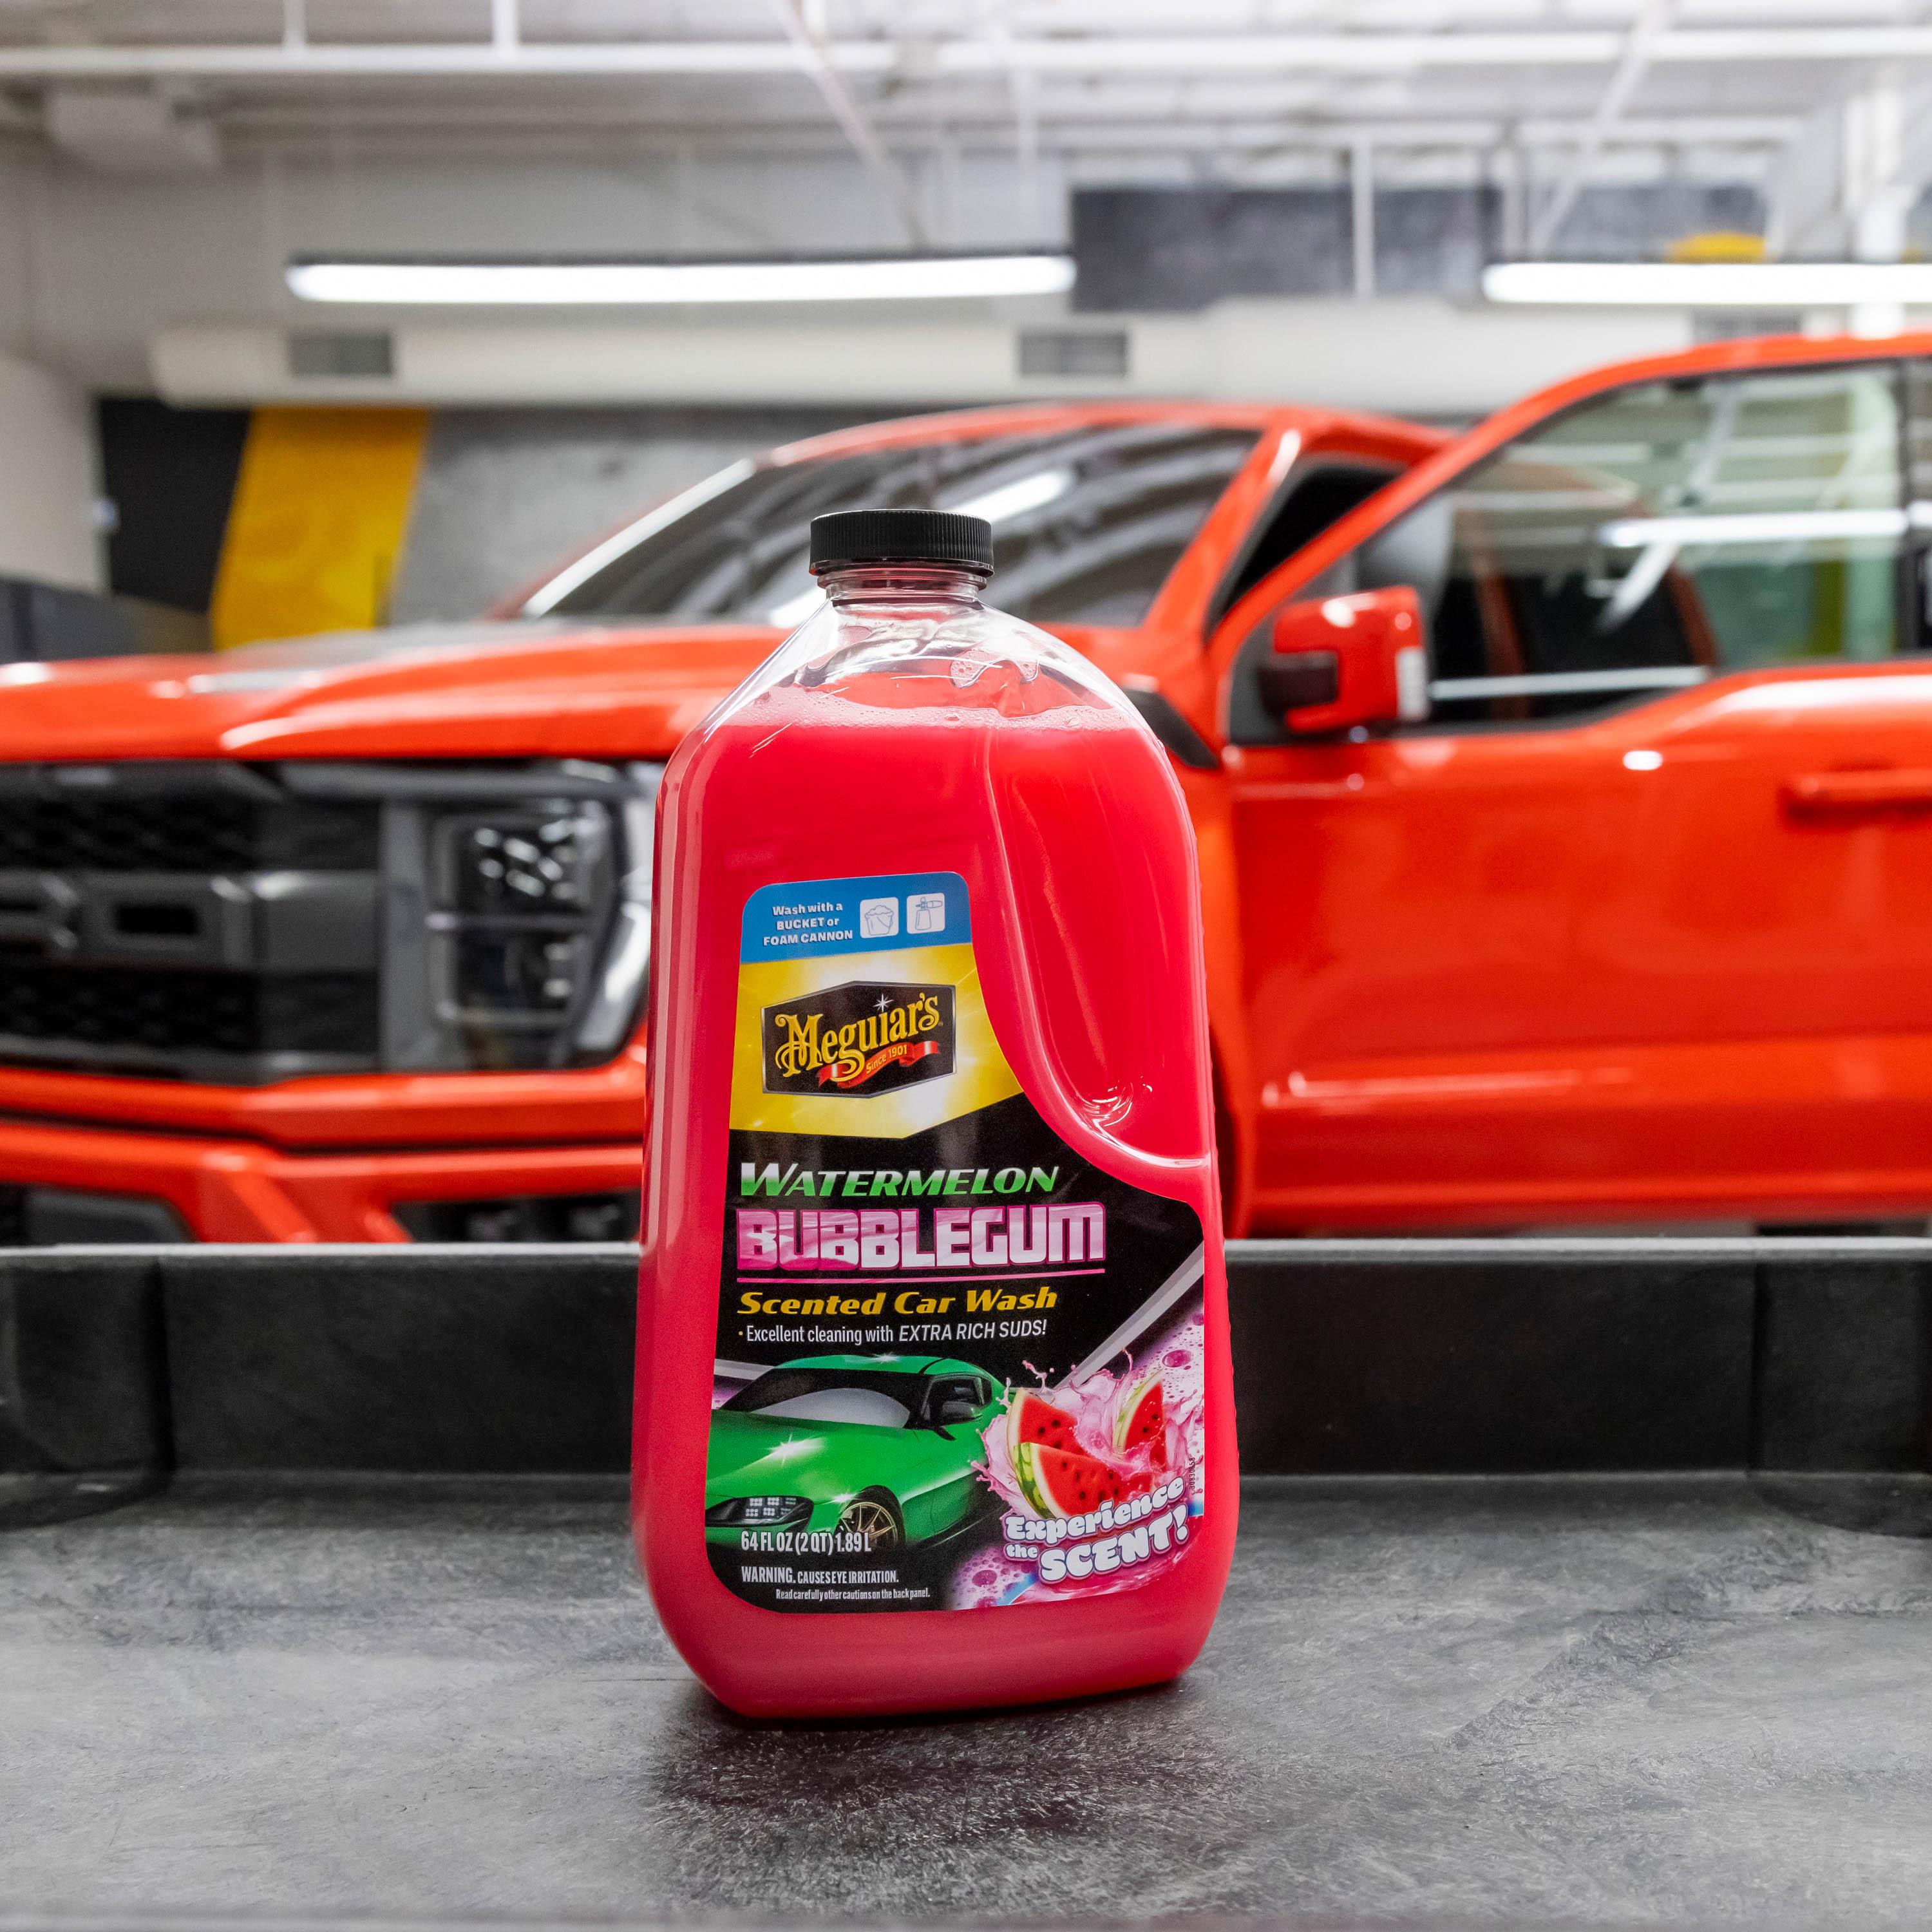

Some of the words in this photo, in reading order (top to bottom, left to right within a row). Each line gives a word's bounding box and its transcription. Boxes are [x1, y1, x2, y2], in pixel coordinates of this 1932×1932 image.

[772, 904, 805, 916] Wash
[808, 902, 833, 913] with
[836, 903, 843, 911] a
[777, 918, 824, 931] BUCKET
[826, 918, 840, 926] or
[763, 934, 799, 946] FOAM
[800, 931, 853, 943] CANNON
[775, 992, 940, 1082] Meguiar's
[866, 1055, 887, 1074] Since
[888, 1045, 907, 1061] 1901
[741, 1162, 1059, 1197] WATERMELON
[737, 1202, 1106, 1271] BUBBLEGUM
[737, 1291, 886, 1315] Scented
[895, 1290, 955, 1314] Car
[967, 1286, 1058, 1312] Wash
[808, 1324, 862, 1345] cleaning
[865, 1324, 893, 1342] with
[899, 1323, 952, 1342] EXTRA
[957, 1321, 994, 1340] RICH
[999, 1320, 1047, 1338] SUDS!
[1005, 1477, 1185, 1544] Experience
[741, 1531, 758, 1551] 64
[761, 1531, 774, 1551] FL
[776, 1532, 793, 1551] OZ
[795, 1531, 808, 1555] (2
[811, 1531, 833, 1555] QT)
[837, 1532, 862, 1552] 1.89
[865, 1532, 871, 1551] L
[1006, 1544, 1039, 1558] the
[1040, 1504, 1188, 1582] SCENT!
[741, 1566, 796, 1584] WARNING.
[797, 1571, 831, 1584] CAUSES
[832, 1571, 847, 1584] EYE
[849, 1570, 899, 1584] IRRITATION.
[776, 1589, 793, 1600] Read
[793, 1588, 823, 1602] carefully
[824, 1588, 842, 1600] other
[842, 1589, 872, 1600] cautions
[873, 1591, 880, 1599] on
[882, 1589, 892, 1598] the
[893, 1588, 909, 1599] back
[909, 1587, 931, 1600] panel.
